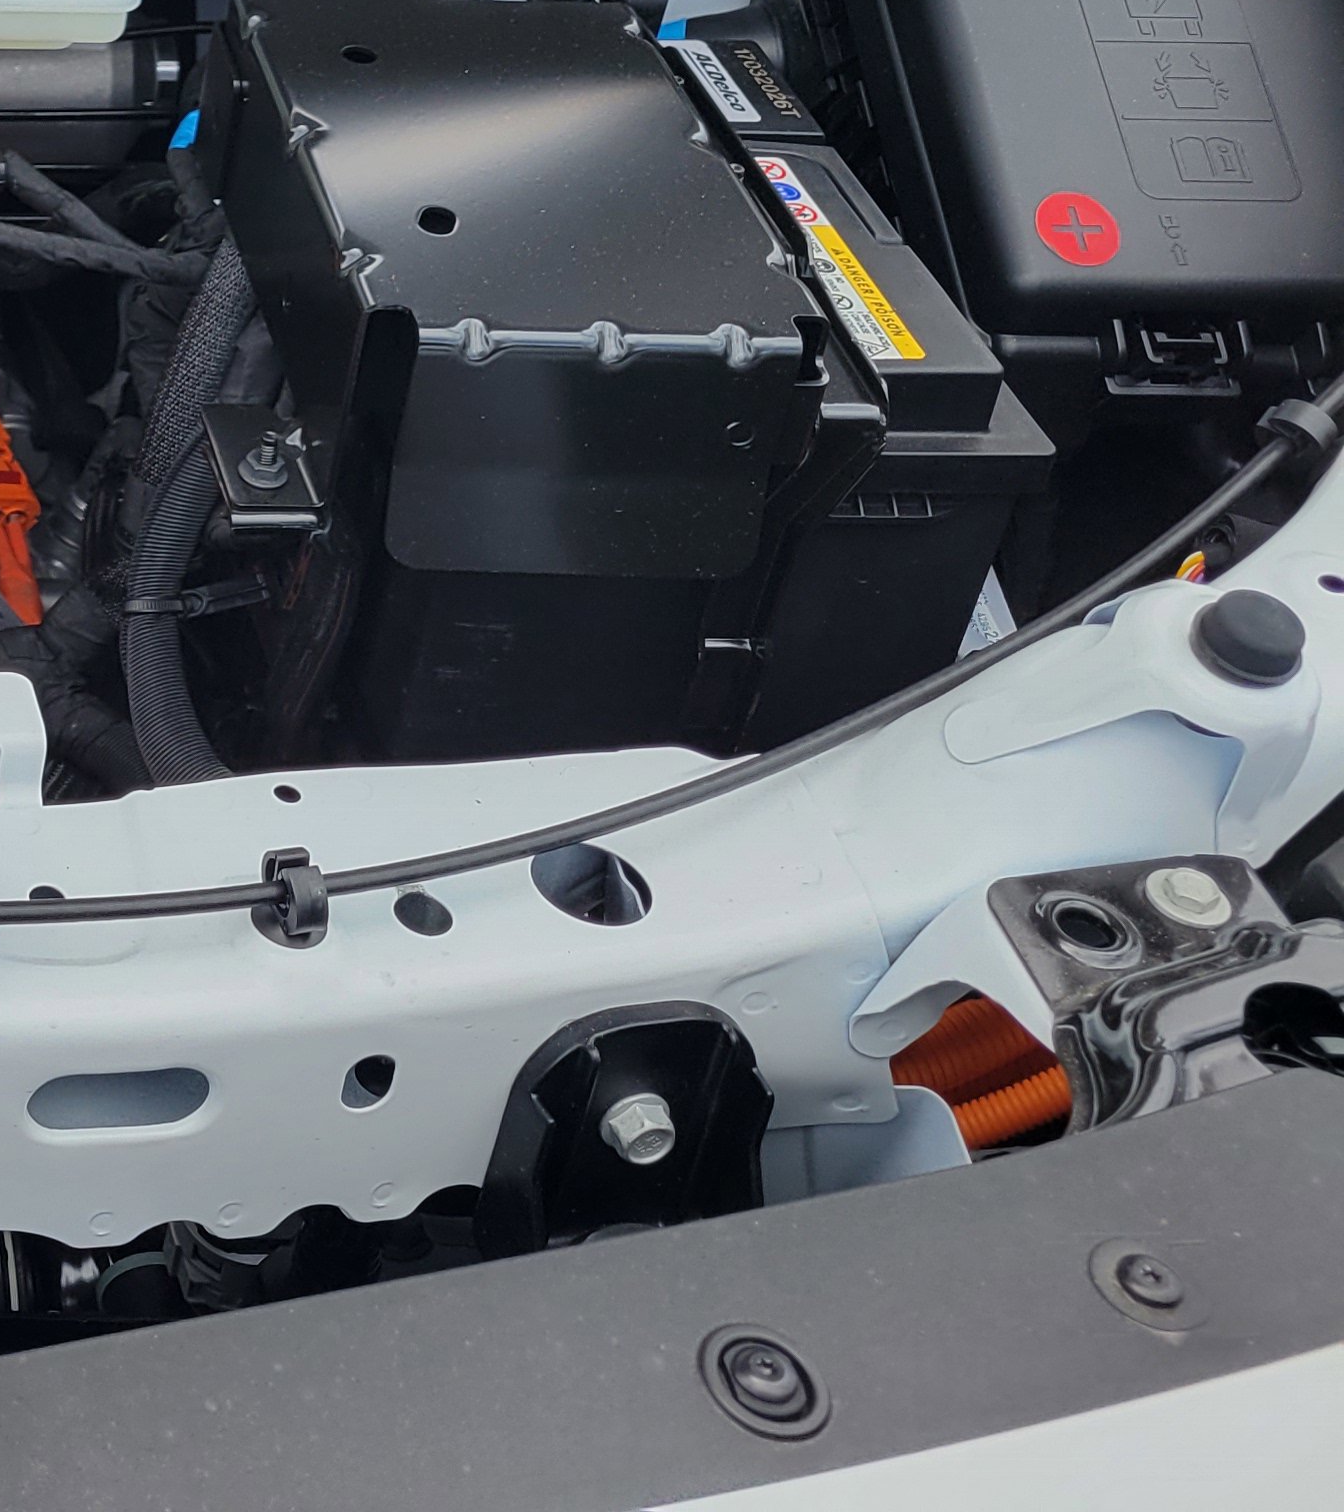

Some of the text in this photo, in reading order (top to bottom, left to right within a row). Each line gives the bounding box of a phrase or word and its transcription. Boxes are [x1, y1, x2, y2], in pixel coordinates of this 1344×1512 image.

[692, 53, 745, 112] ACDelco
[733, 48, 802, 117] 17032026T
[838, 258, 874, 294] DANGER
[871, 302, 904, 336] POISON
